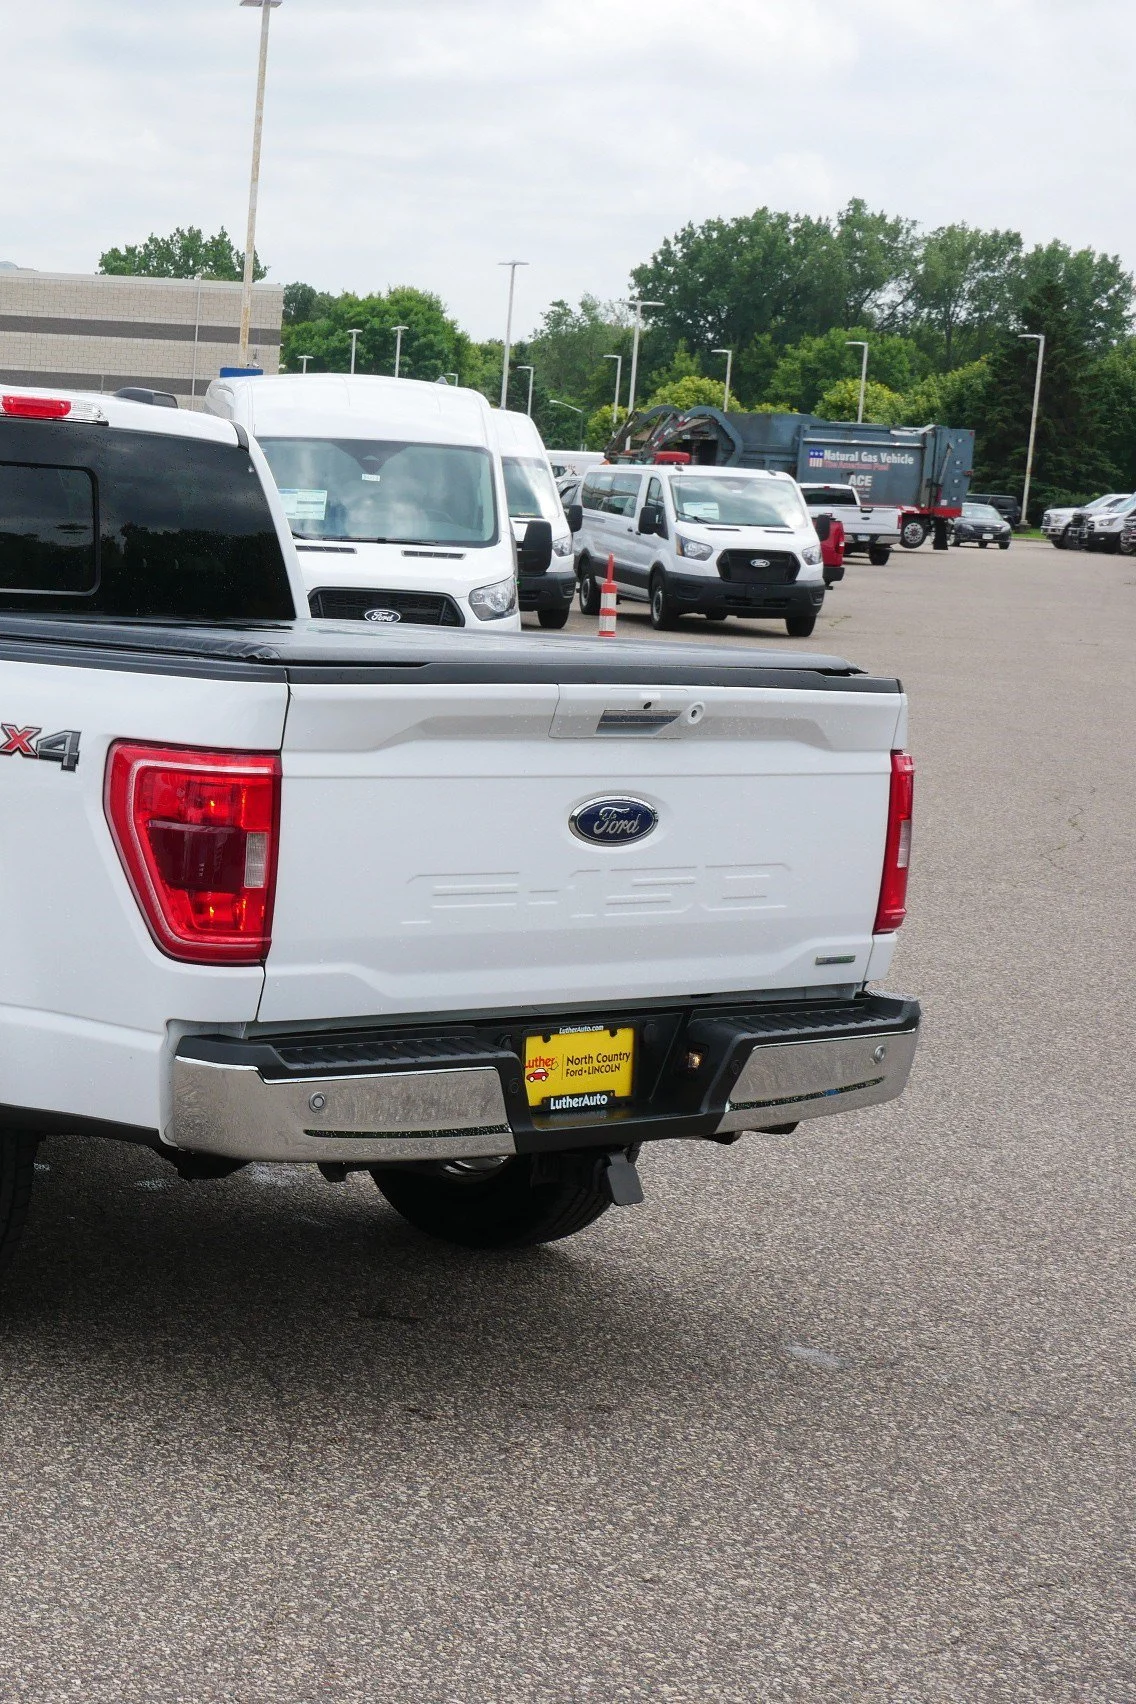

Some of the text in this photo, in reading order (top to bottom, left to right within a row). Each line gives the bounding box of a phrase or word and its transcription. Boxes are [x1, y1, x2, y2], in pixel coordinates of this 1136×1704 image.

[824, 449, 914, 465] Natural Gas Vehicle
[848, 474, 872, 487] ACE
[593, 806, 641, 834] Ford
[559, 1025, 604, 1034] LutherAuto.com
[525, 1056, 555, 1069] Luther
[566, 1051, 631, 1066] North Country
[550, 1093, 608, 1110] LutherAuto
